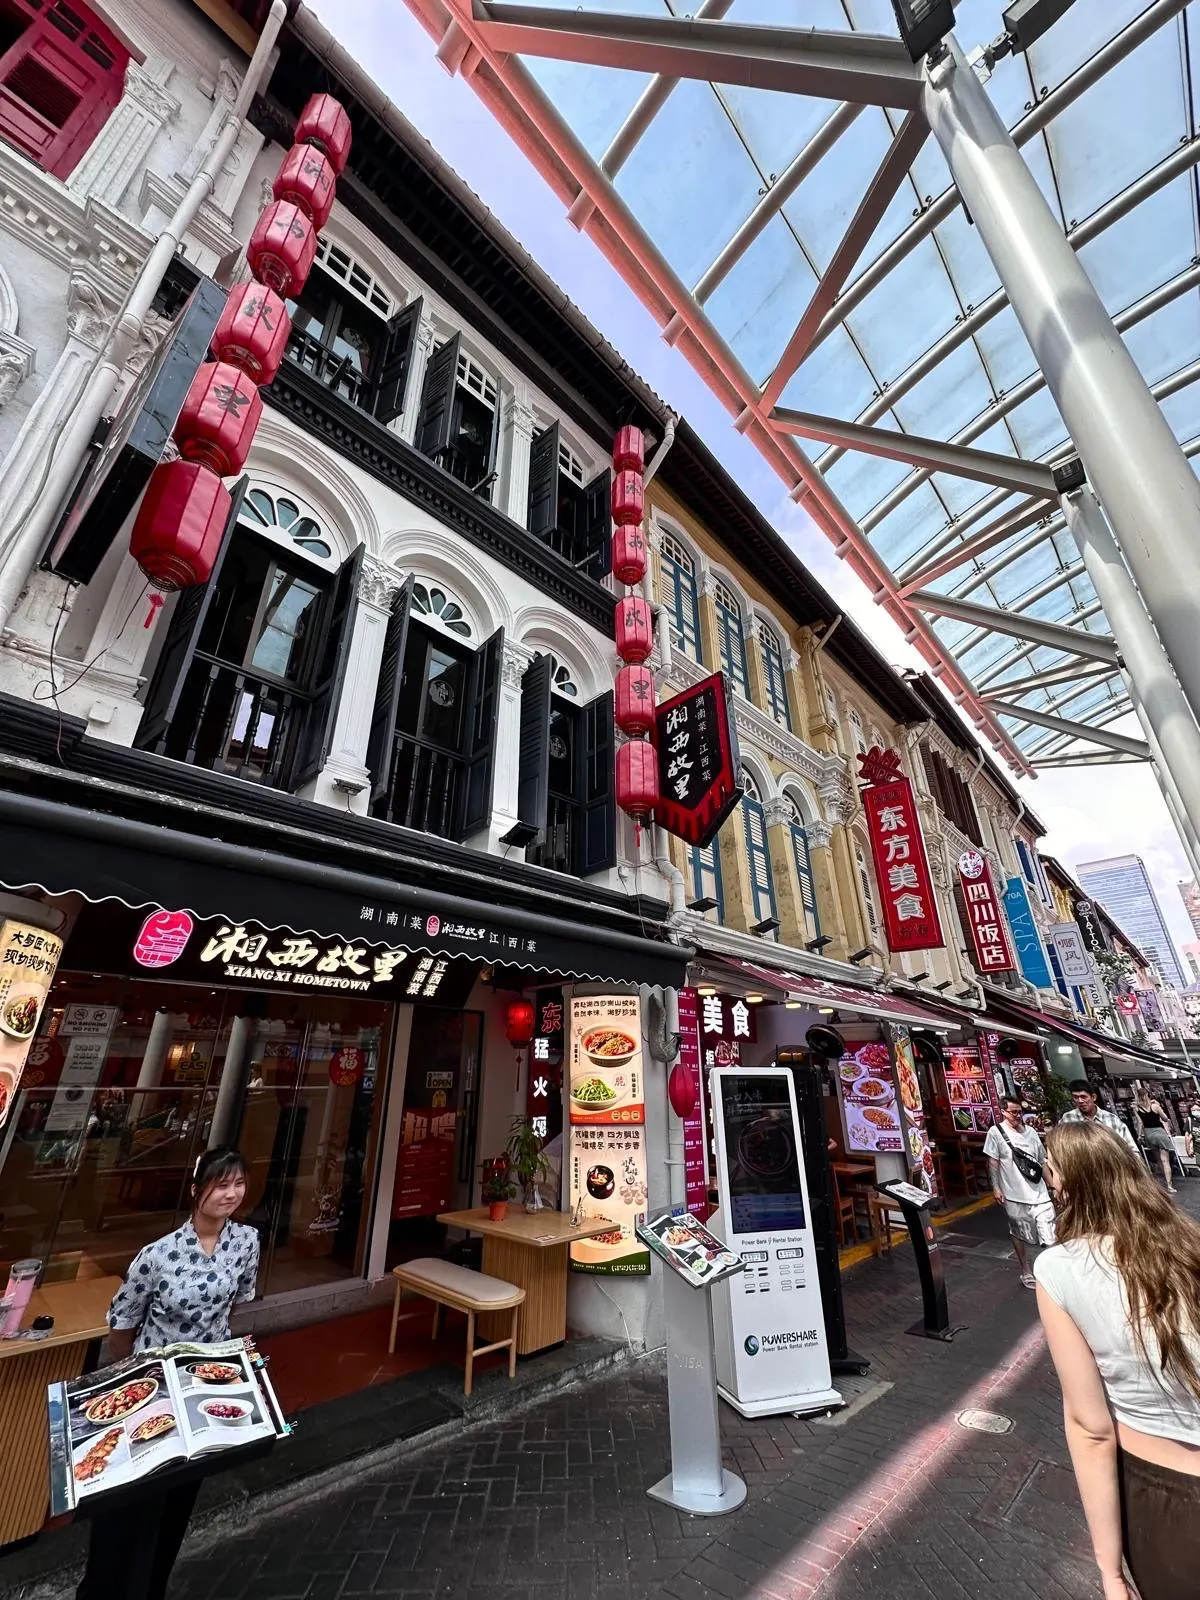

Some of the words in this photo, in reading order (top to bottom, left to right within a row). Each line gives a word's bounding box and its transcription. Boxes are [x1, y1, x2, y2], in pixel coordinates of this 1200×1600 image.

[666, 705, 694, 800] 湘西故里
[876, 804, 925, 922] 东方美食
[1006, 891, 1022, 900] 70A
[966, 881, 1006, 965] 四川饭店
[1010, 912, 1038, 952] SPA
[1083, 915, 1101, 952] TATTOO
[200, 925, 408, 983] 湘西故里
[292, 973, 371, 992] HOMETOWN
[406, 956, 435, 996] 湖南菜
[421, 959, 449, 998] 江西菜
[541, 1002, 562, 1033] 东
[702, 995, 751, 1038] 美食
[432, 1078, 452, 1087] OPEN
[402, 1111, 457, 1144] 招聘
[761, 1329, 818, 1346] POWERSHARE
